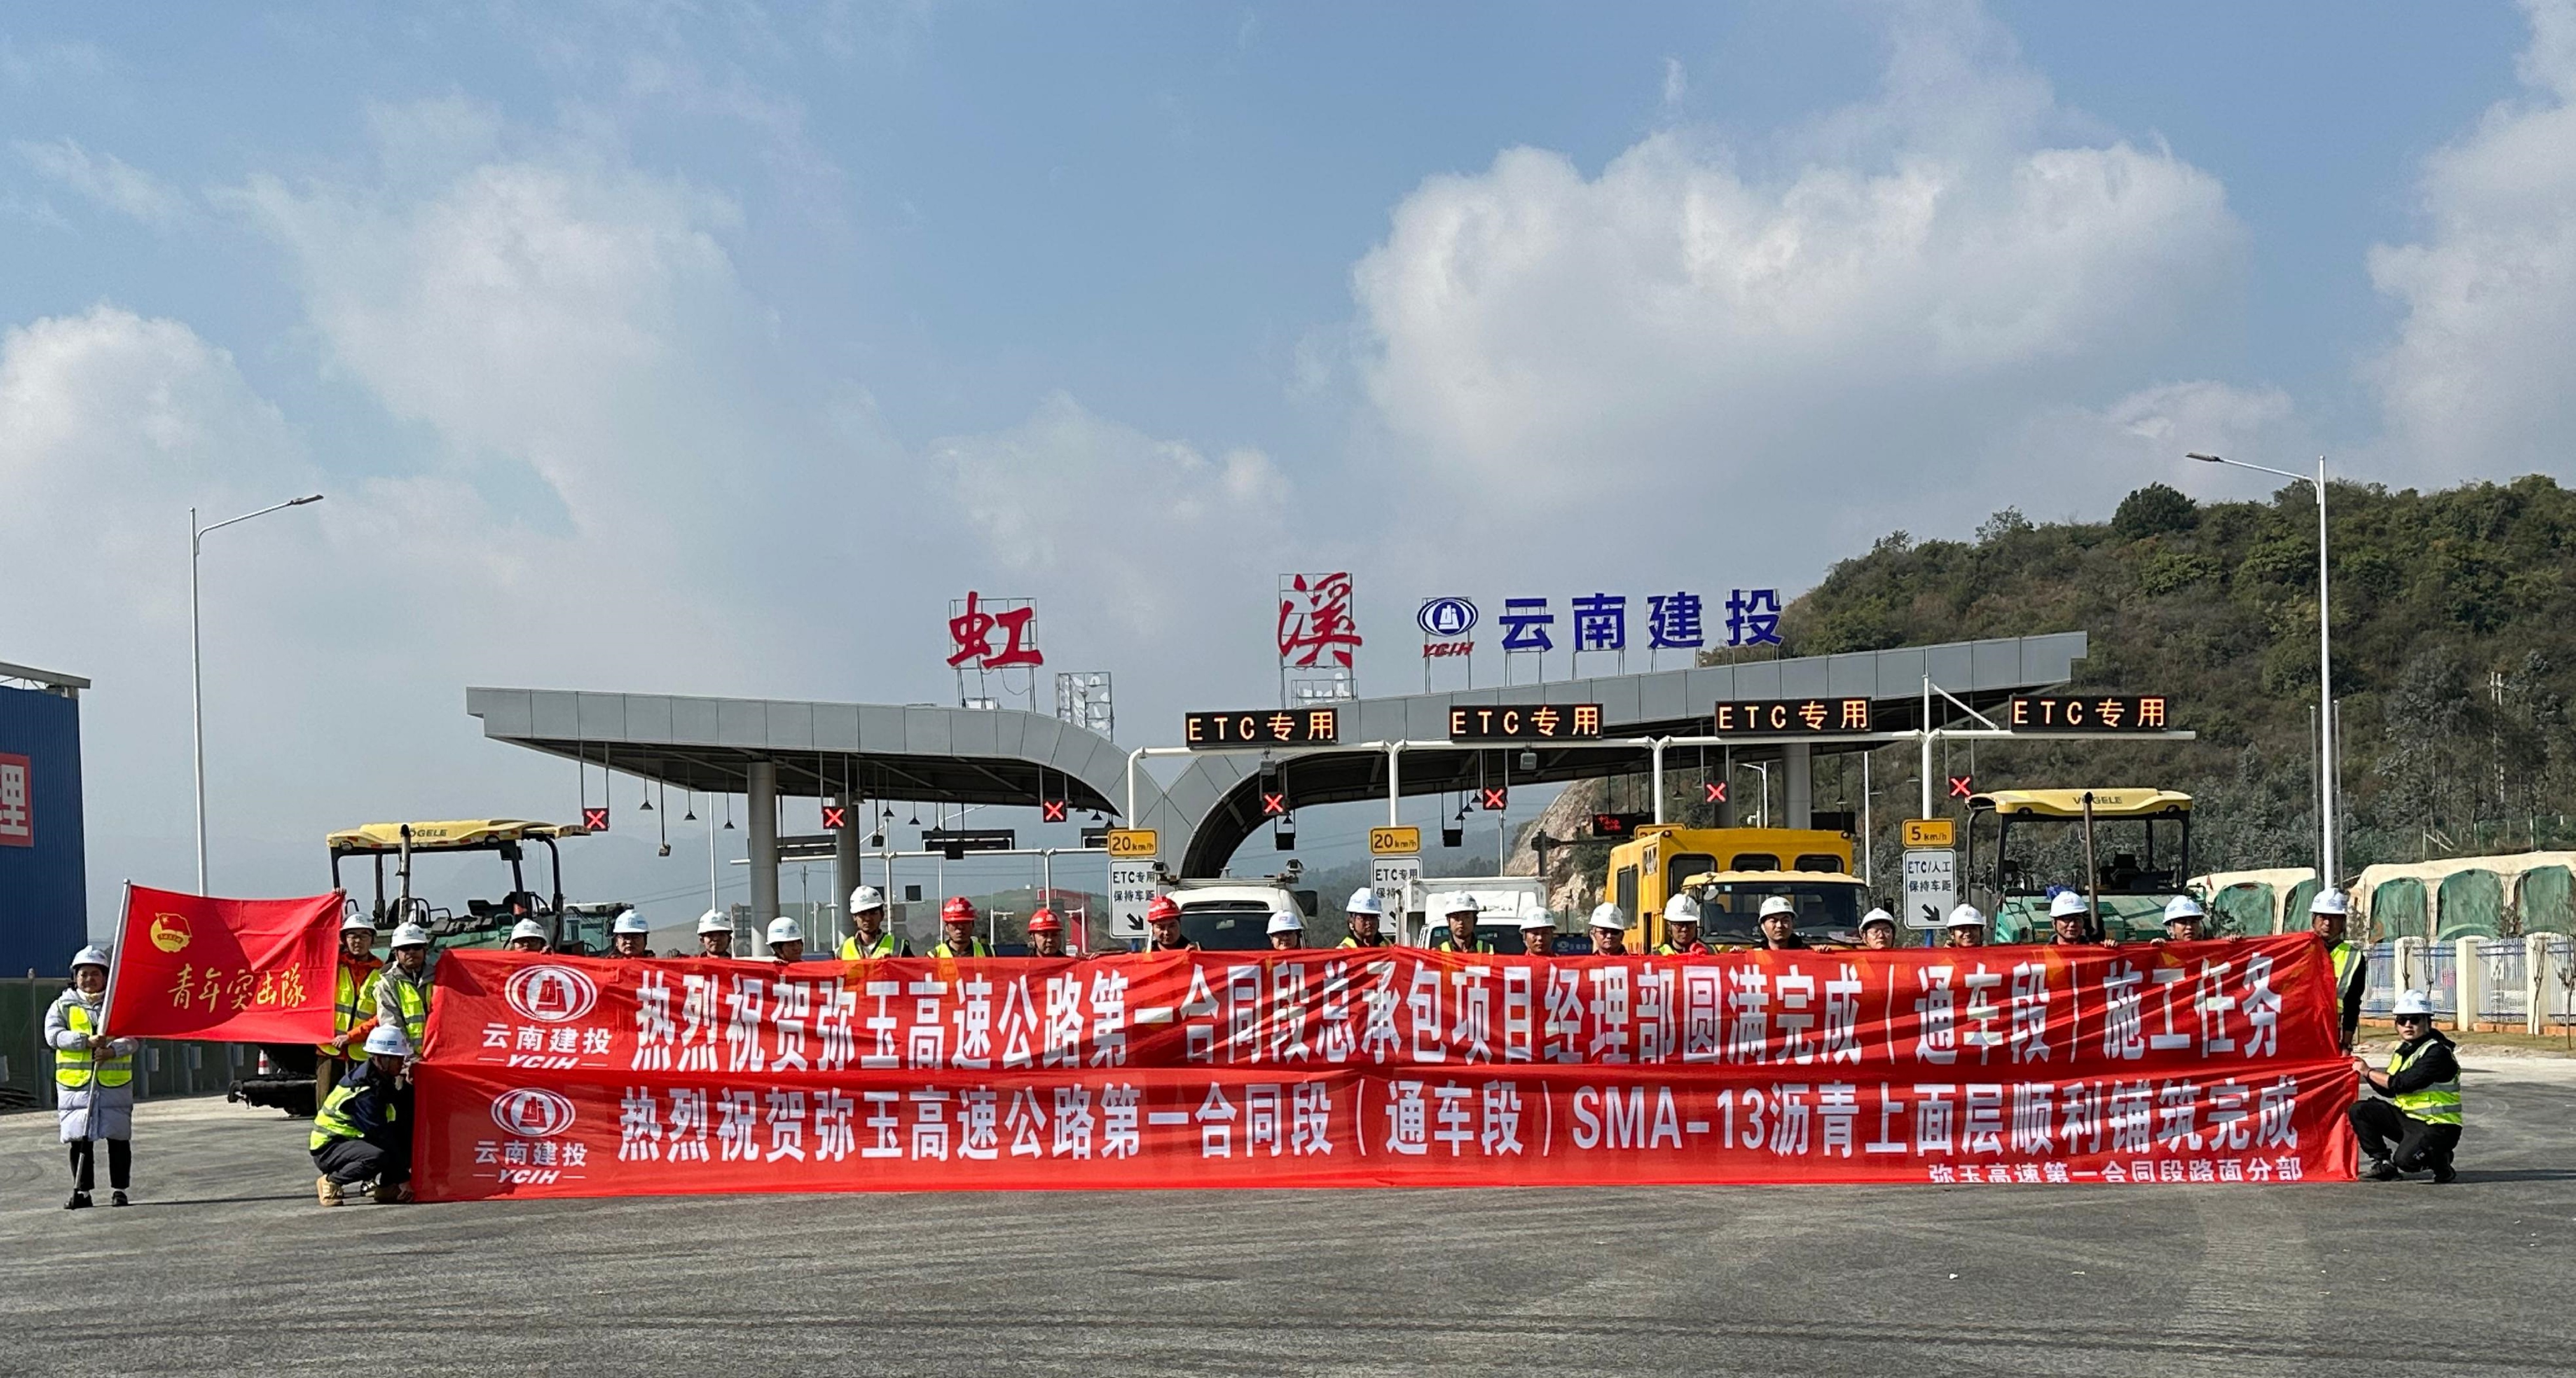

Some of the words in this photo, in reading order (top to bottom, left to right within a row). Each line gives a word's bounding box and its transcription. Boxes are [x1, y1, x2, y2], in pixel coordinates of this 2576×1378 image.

[1499, 589, 1785, 651] 云南建投
[1422, 641, 1475, 658] YCIH
[2072, 796, 2122, 804] VGELE
[1909, 880, 1952, 892] 保持车距
[483, 1023, 612, 1055] 云南建投
[506, 1054, 580, 1069] YCIH
[474, 1140, 588, 1167] 云南建投
[498, 1169, 561, 1184] YCIH
